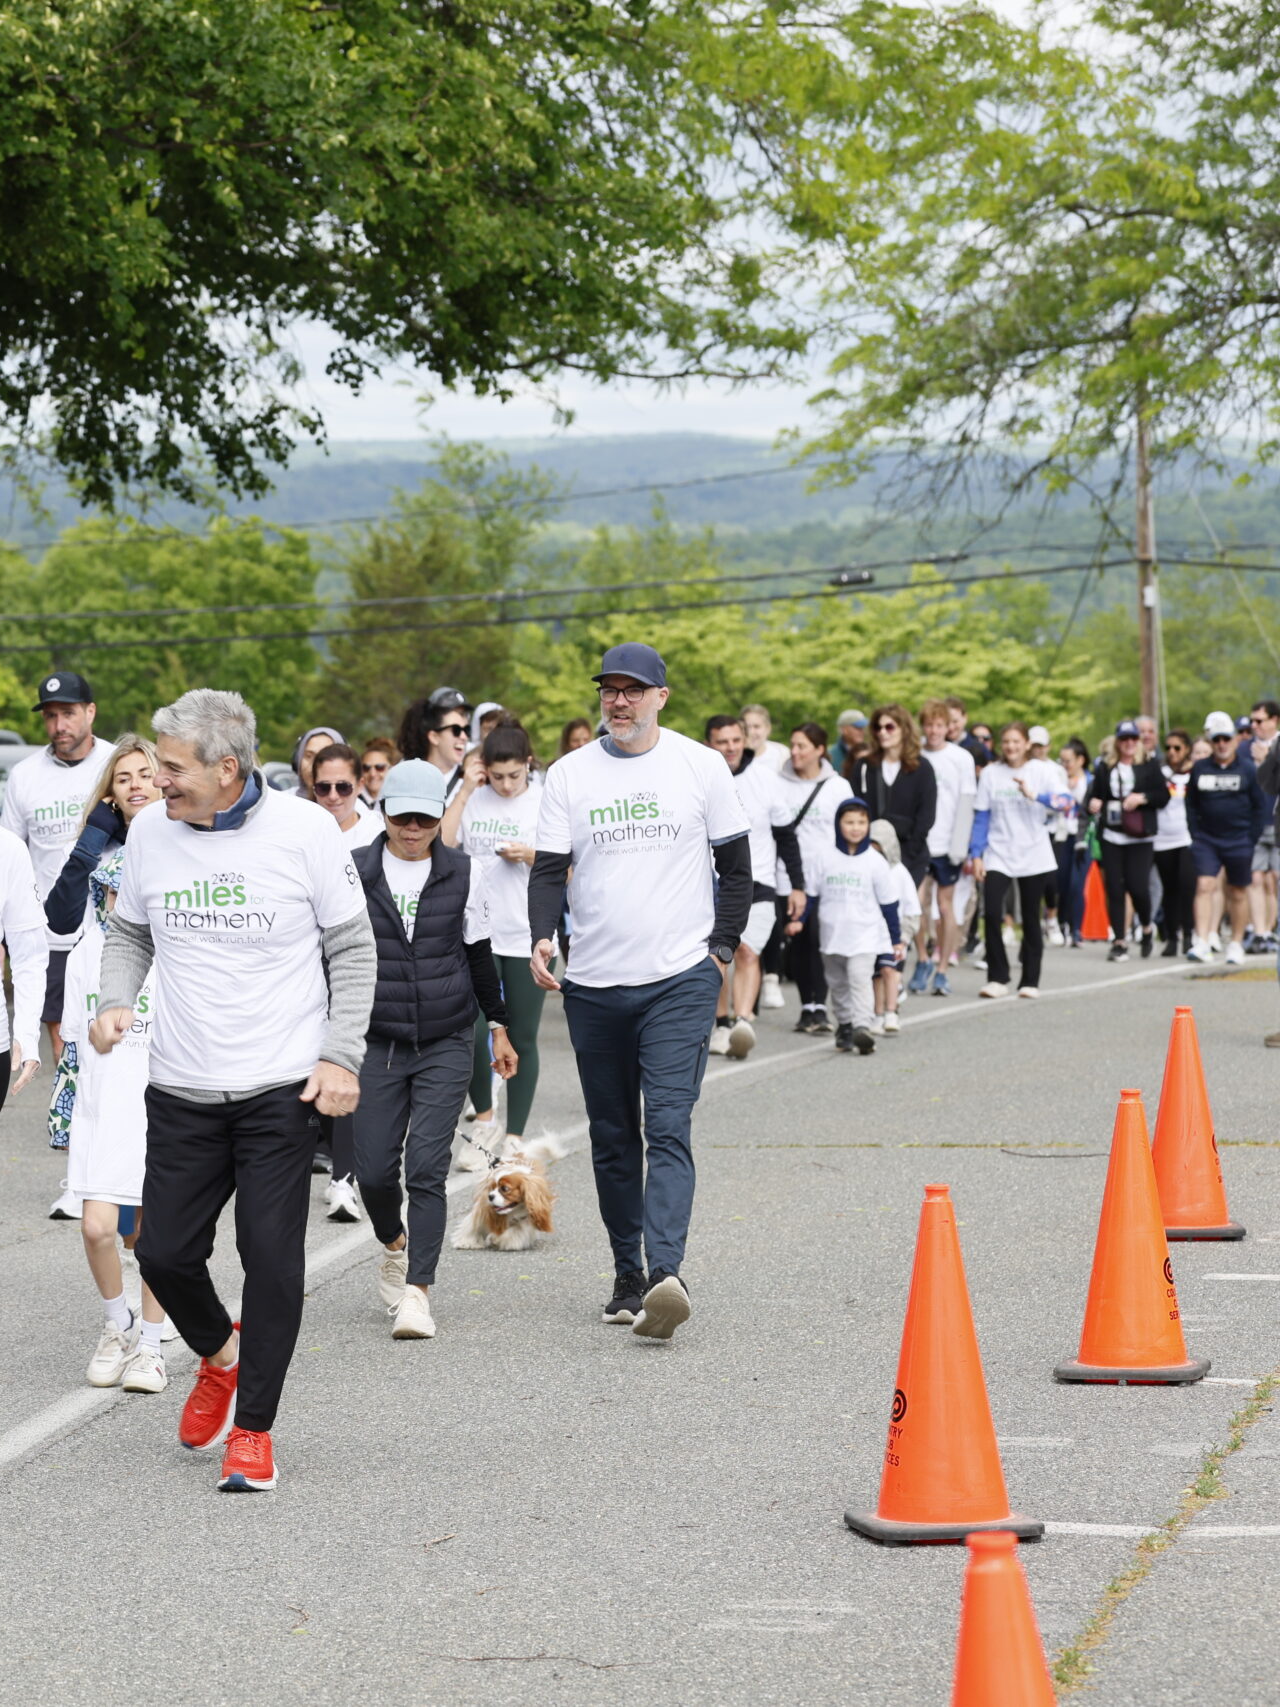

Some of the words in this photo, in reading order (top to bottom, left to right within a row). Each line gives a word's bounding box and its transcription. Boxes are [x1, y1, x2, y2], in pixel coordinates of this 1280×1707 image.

[590, 798, 659, 826] miles
[37, 819, 78, 835] math
[471, 818, 519, 836] miles
[592, 823, 682, 845] matheny
[164, 880, 246, 910] miles
[250, 895, 265, 905] for
[392, 894, 419, 917] ile
[166, 910, 276, 933] matheny
